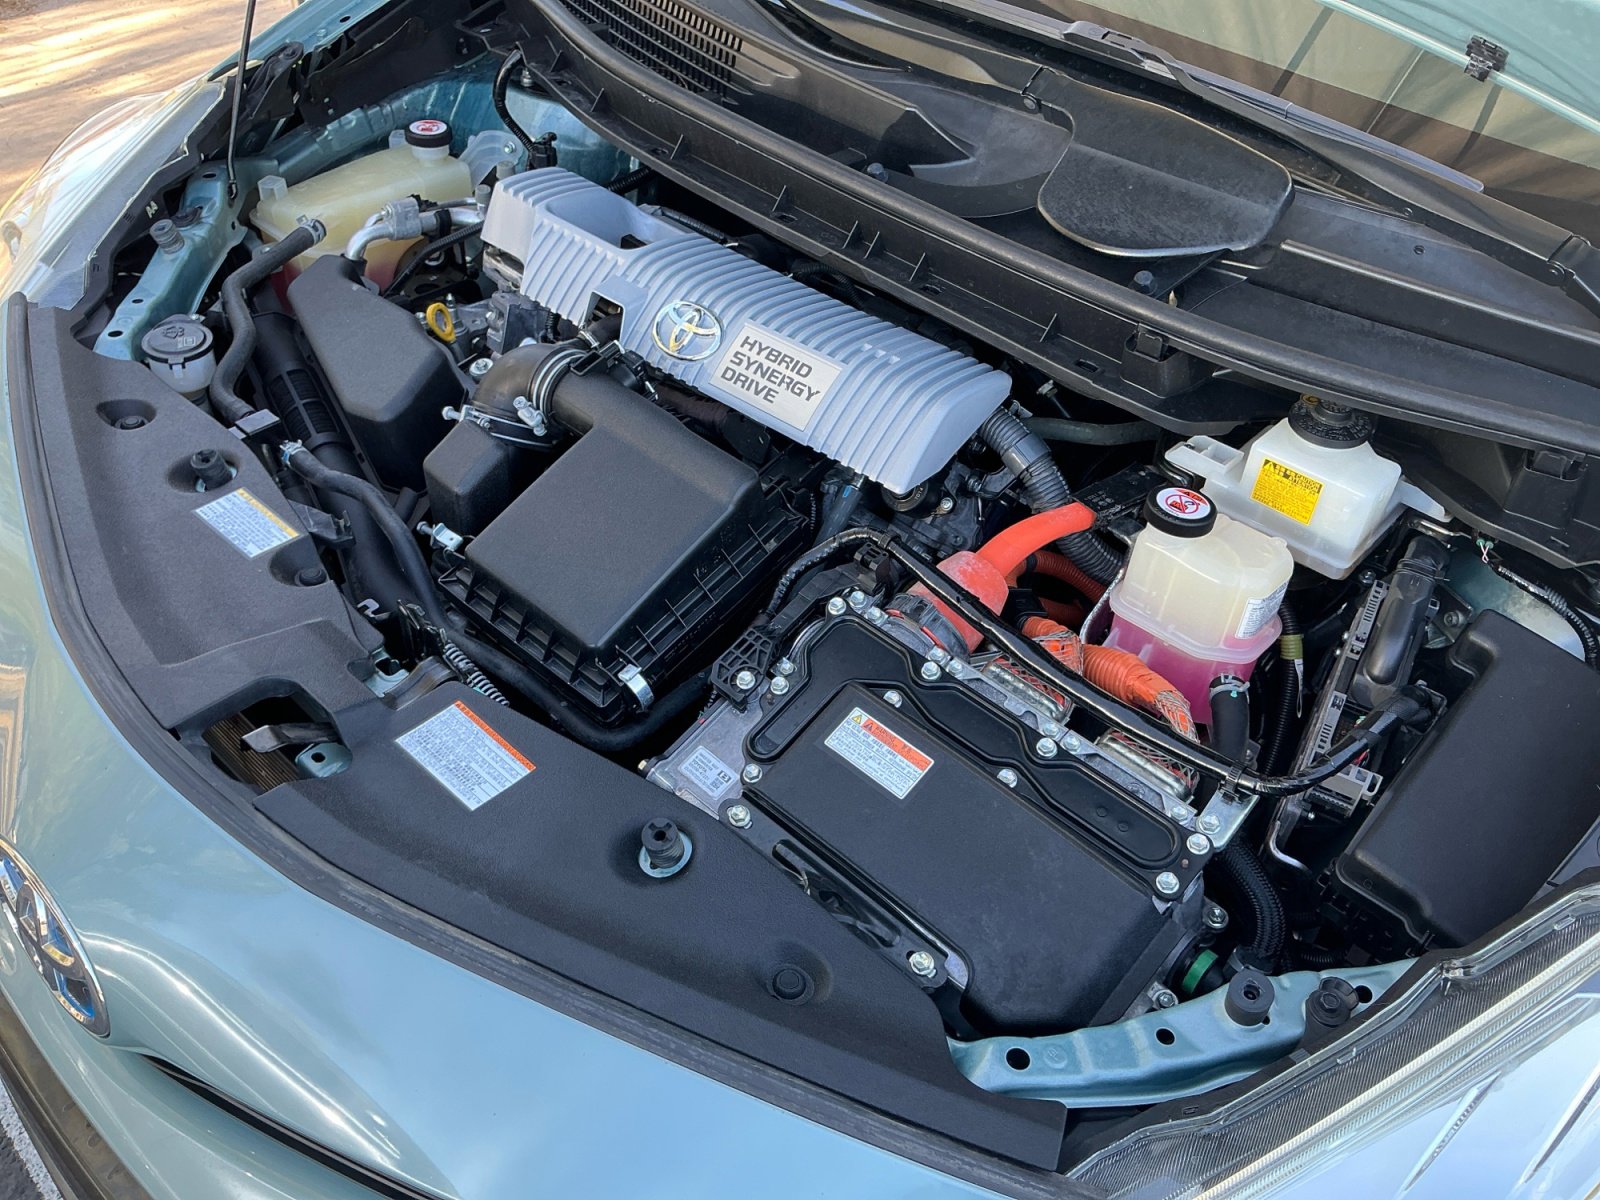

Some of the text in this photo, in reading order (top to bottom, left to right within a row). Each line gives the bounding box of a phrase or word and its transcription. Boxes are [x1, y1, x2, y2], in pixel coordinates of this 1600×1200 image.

[730, 351, 821, 402] SYNERGY
[740, 336, 813, 379] HYBRID
[721, 366, 779, 404] DRIVE
